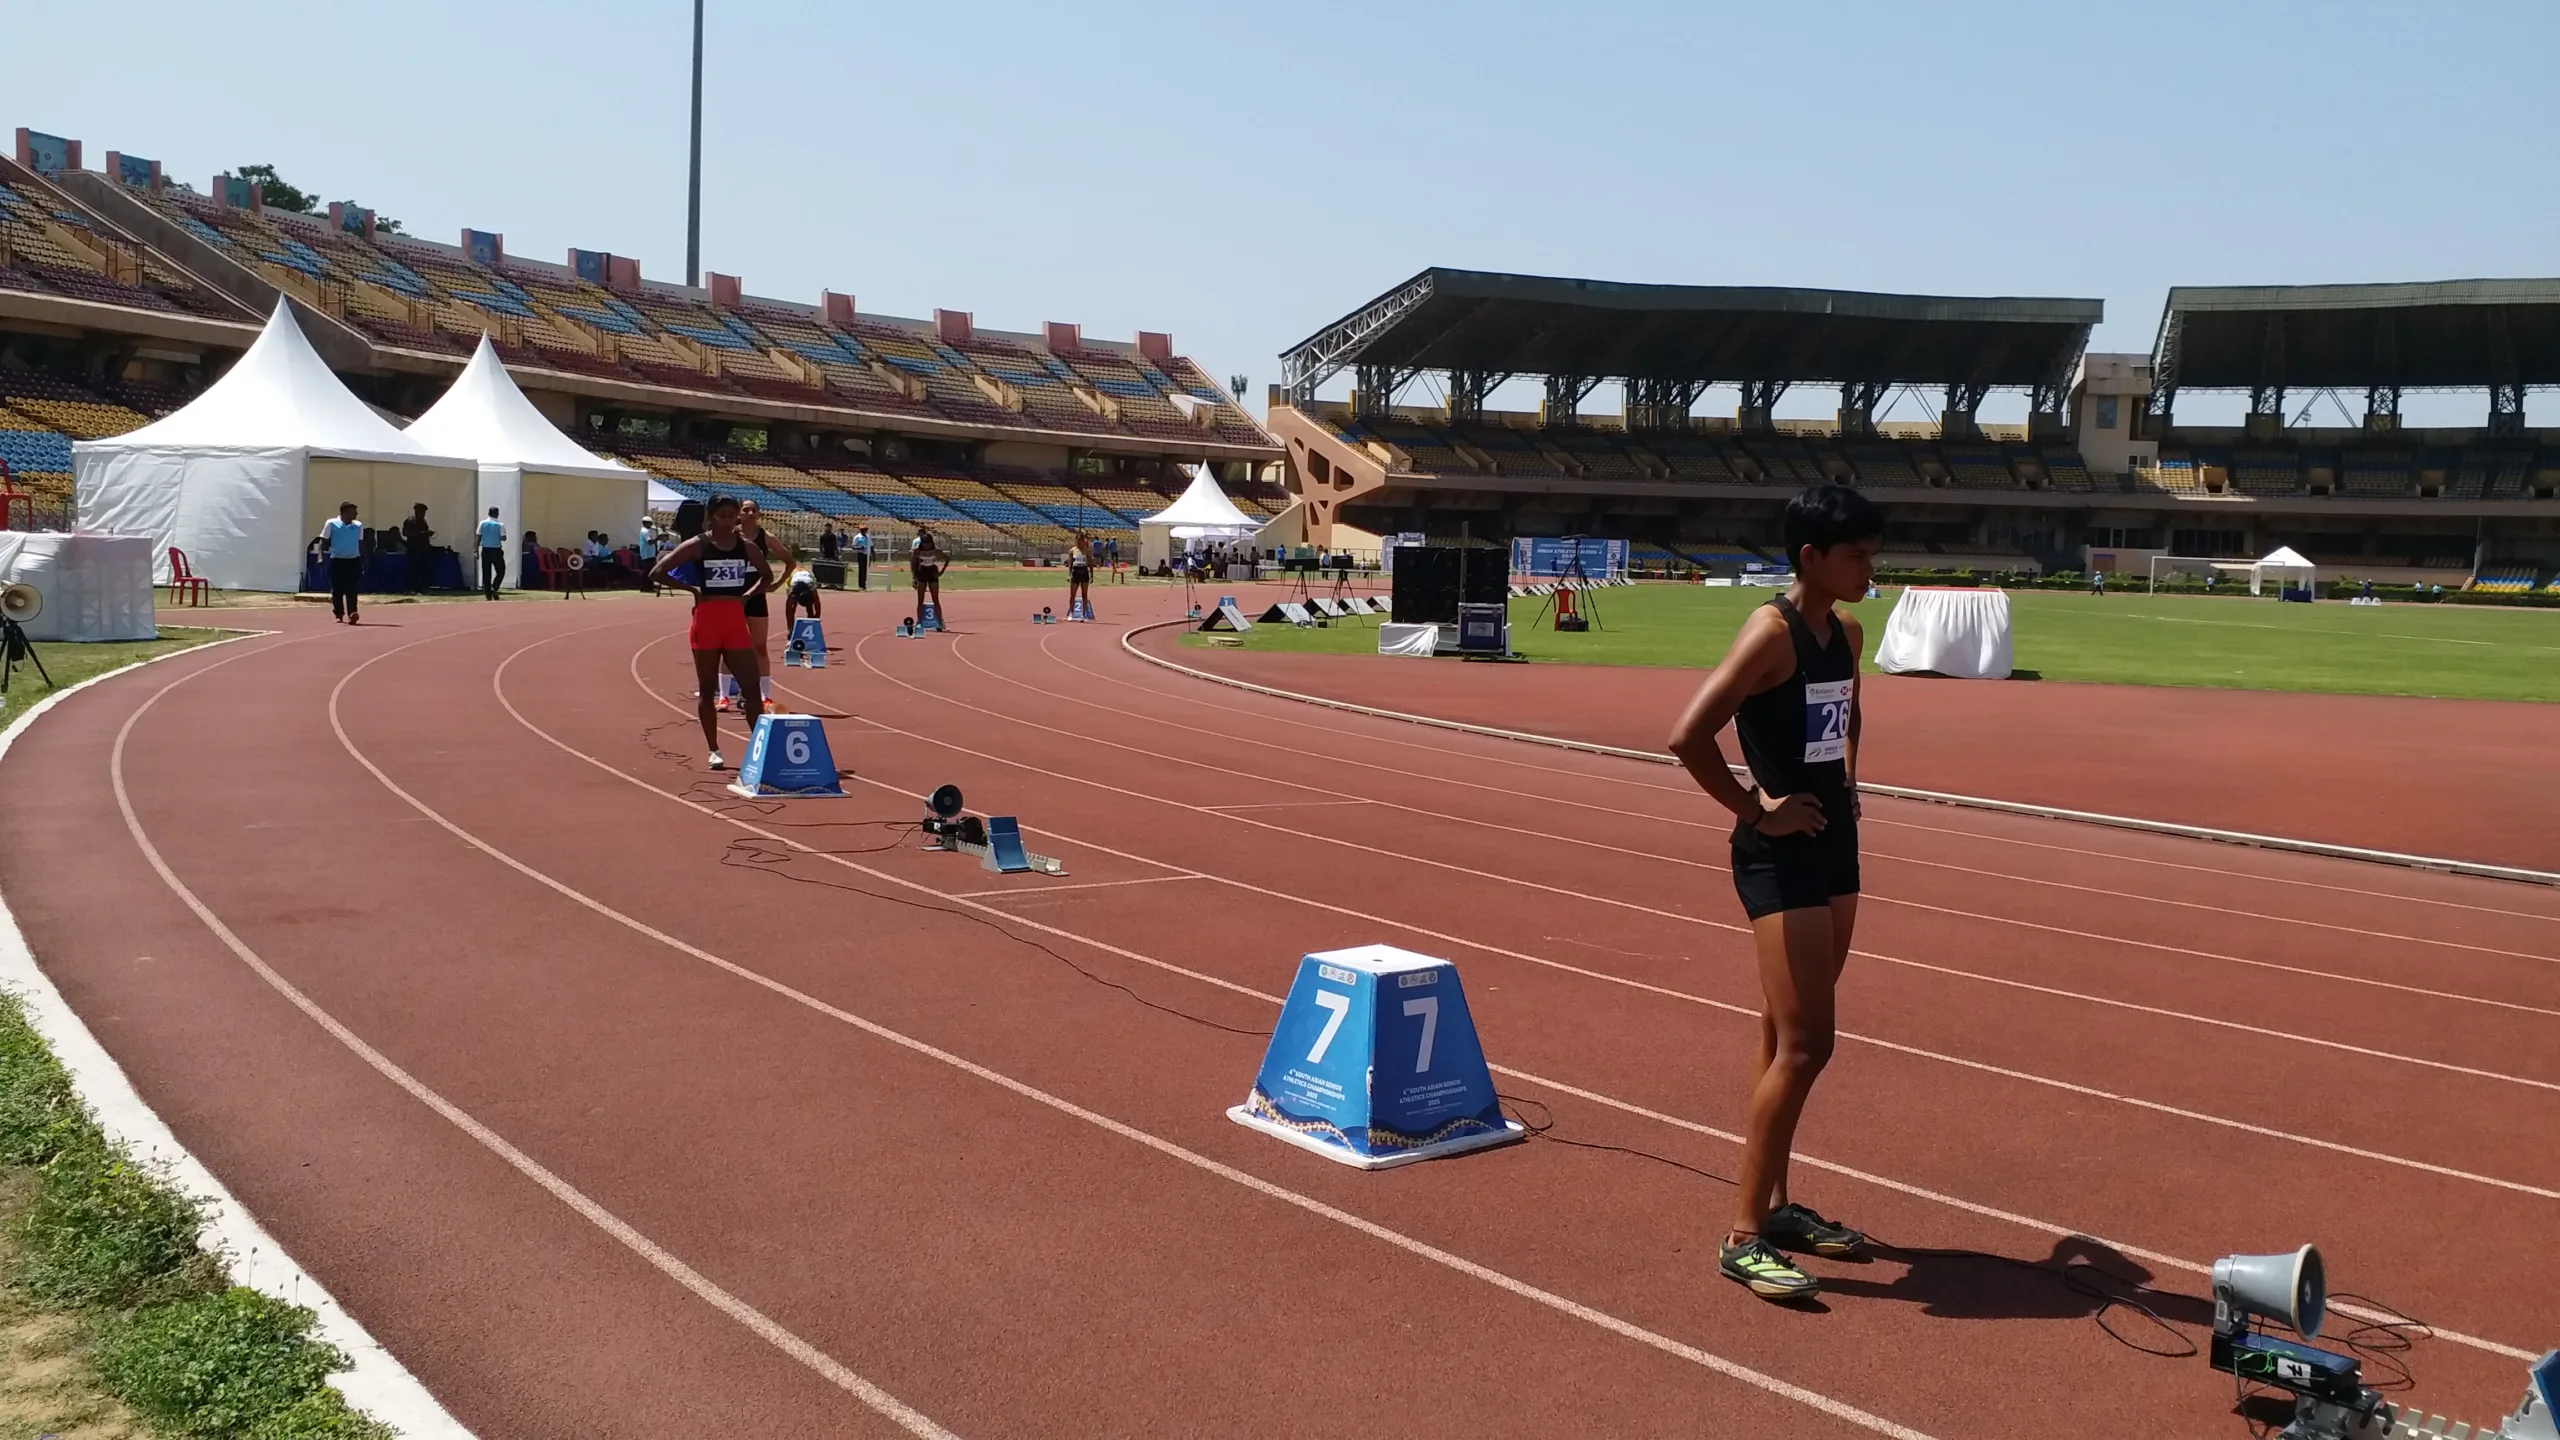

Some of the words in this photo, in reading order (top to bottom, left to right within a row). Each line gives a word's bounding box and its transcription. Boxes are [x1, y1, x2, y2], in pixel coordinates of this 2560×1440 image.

[712, 567, 738, 580] 231
[925, 608, 934, 620] 3
[1074, 602, 1082, 612] 2
[802, 625, 814, 640] 4
[752, 729, 764, 762] 6
[786, 731, 810, 764] 6
[1306, 989, 1350, 1064] 7
[1402, 996, 1438, 1073] 7
[1282, 1074, 1306, 1088] ATHLETICS
[1307, 1083, 1345, 1100] CHAMPIONSHIPS
[1400, 1094, 1426, 1104] ATHLETICS
